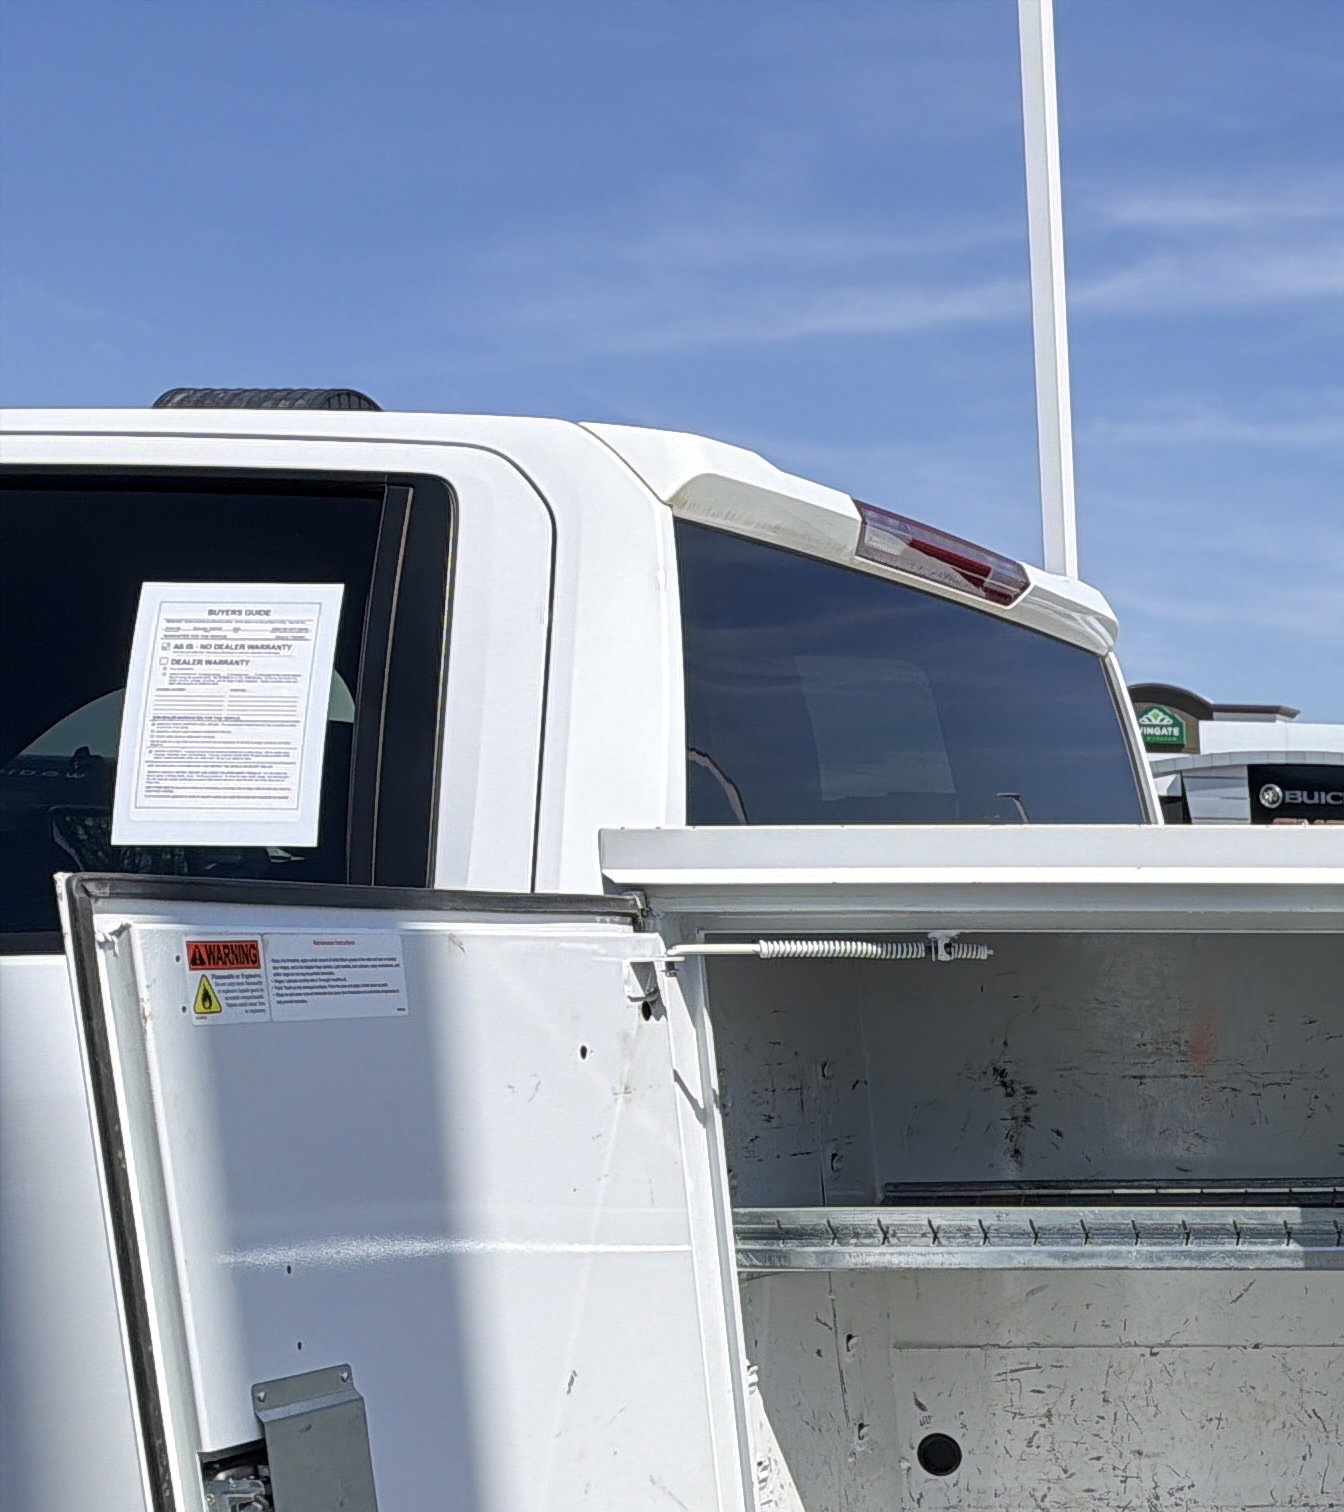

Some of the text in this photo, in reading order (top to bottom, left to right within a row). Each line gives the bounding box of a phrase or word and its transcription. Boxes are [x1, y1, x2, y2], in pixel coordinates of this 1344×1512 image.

[207, 608, 272, 617] BUYERS GUIDE
[200, 643, 213, 651] NO
[214, 643, 246, 651] DEALER
[170, 658, 250, 666] DEALER WARRANTY
[205, 943, 258, 966] WARNING
